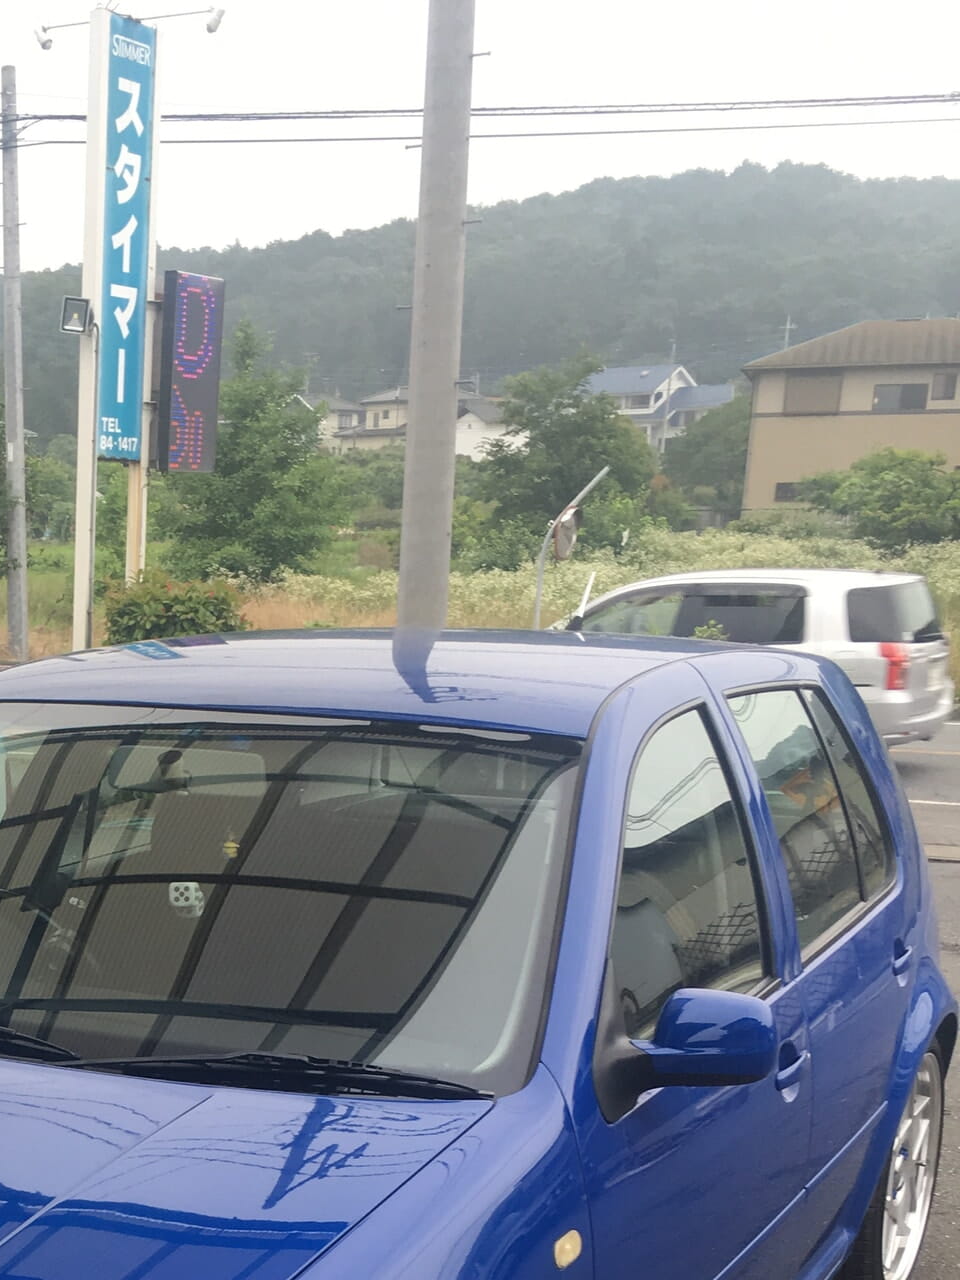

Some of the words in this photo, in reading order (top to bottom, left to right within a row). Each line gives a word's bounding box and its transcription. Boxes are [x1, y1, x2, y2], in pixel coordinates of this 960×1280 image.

[110, 77, 144, 403] スタイマー
[101, 417, 122, 433] TEL
